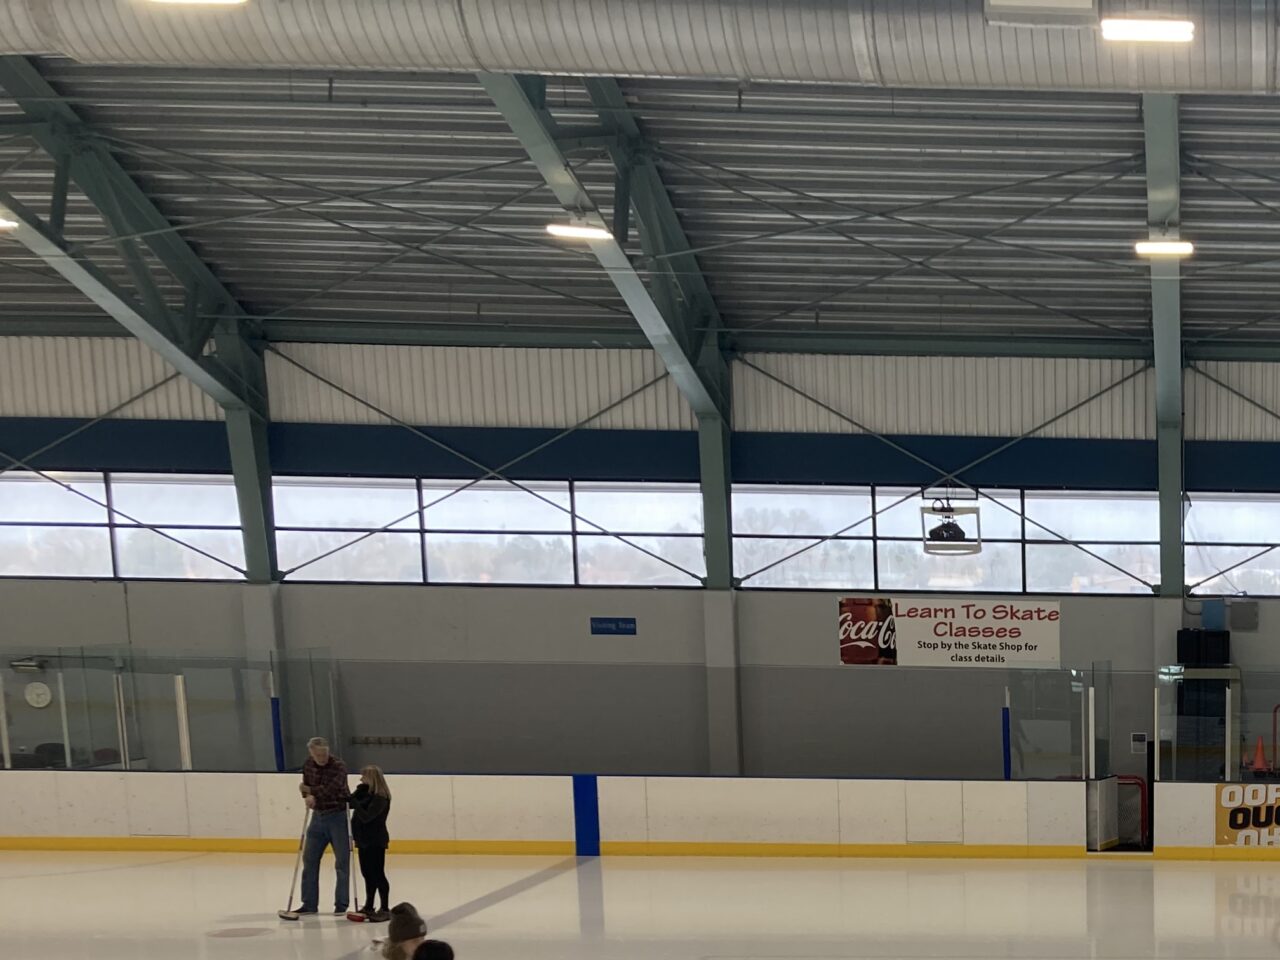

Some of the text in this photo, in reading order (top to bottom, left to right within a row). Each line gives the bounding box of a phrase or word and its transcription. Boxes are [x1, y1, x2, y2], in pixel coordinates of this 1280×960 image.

[894, 602, 1060, 621] Learn To Skate
[933, 621, 1022, 638] Classes
[917, 640, 1038, 652] Stop by the Skate Shop for
[950, 653, 1006, 663] class details
